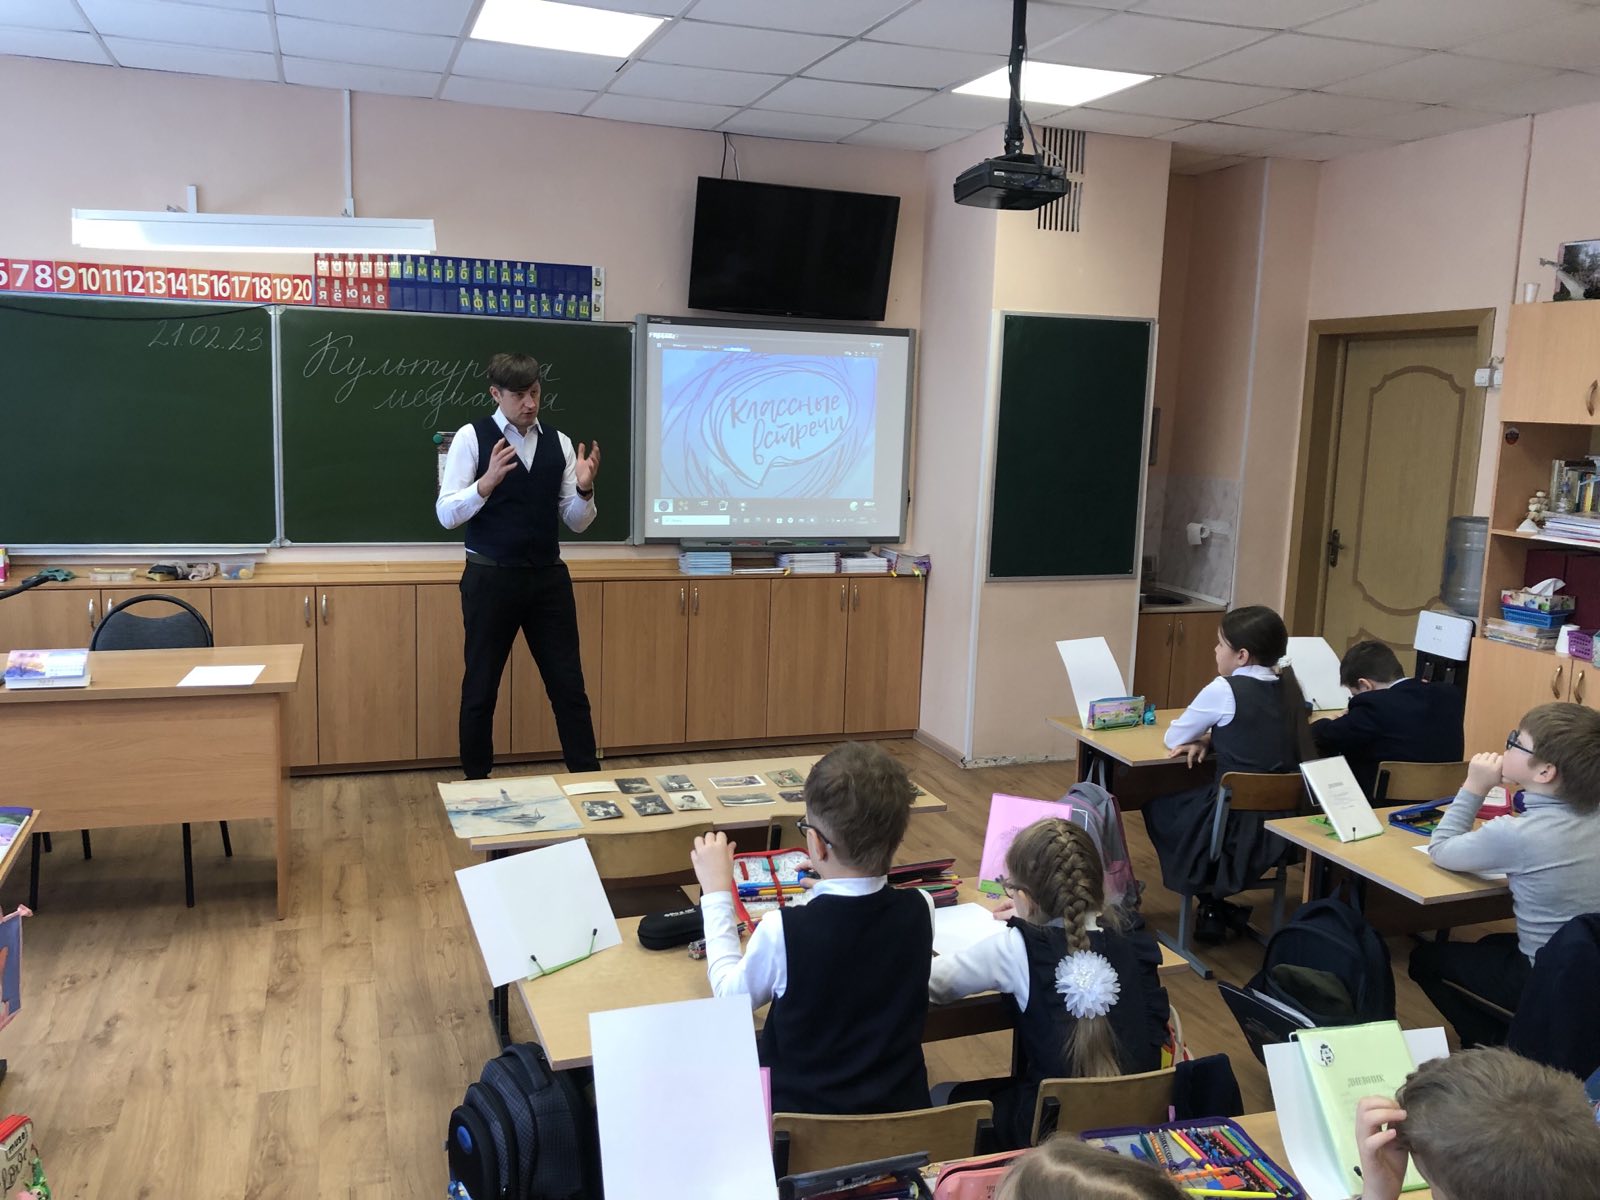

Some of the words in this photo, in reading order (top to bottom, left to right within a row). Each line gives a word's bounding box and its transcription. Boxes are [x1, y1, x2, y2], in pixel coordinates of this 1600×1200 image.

[12, 263, 29, 287] 7
[34, 264, 53, 289] 8
[57, 265, 76, 289] 9
[78, 267, 100, 291] 10
[101, 269, 122, 292] 11
[123, 270, 145, 293] 12
[145, 271, 167, 294] 13
[167, 272, 188, 296] 14
[188, 273, 209, 296] 15
[210, 274, 231, 298] 16
[231, 276, 251, 298] 17
[251, 277, 272, 299] 18
[272, 277, 293, 300] 19
[293, 278, 313, 301] 20
[406, 265, 413, 275] л
[418, 267, 427, 277] м
[433, 269, 440, 279] н
[447, 269, 454, 282] р
[461, 268, 468, 280] б
[476, 270, 483, 280] в
[490, 270, 495, 279] г
[501, 272, 510, 283] д
[514, 273, 524, 282] ж
[529, 274, 535, 283] з
[594, 277, 602, 287] ъ
[319, 290, 327, 300] я
[333, 289, 342, 302] ё
[346, 288, 358, 298] ю
[362, 295, 372, 304] и
[377, 294, 385, 303] е
[461, 297, 469, 307] п
[474, 297, 483, 311] ф
[489, 300, 496, 309] к
[502, 299, 508, 308] т
[514, 299, 524, 308] ш
[530, 304, 536, 313] с
[542, 303, 550, 312] х
[555, 303, 562, 315] ц
[568, 305, 575, 314] ч
[580, 305, 589, 316] щ
[593, 303, 601, 313] ь
[148, 320, 263, 352] 21.02.23
[302, 331, 560, 404] Культуря
[373, 388, 565, 429] медиая
[729, 395, 840, 429] Классные
[752, 415, 845, 465] встречи
